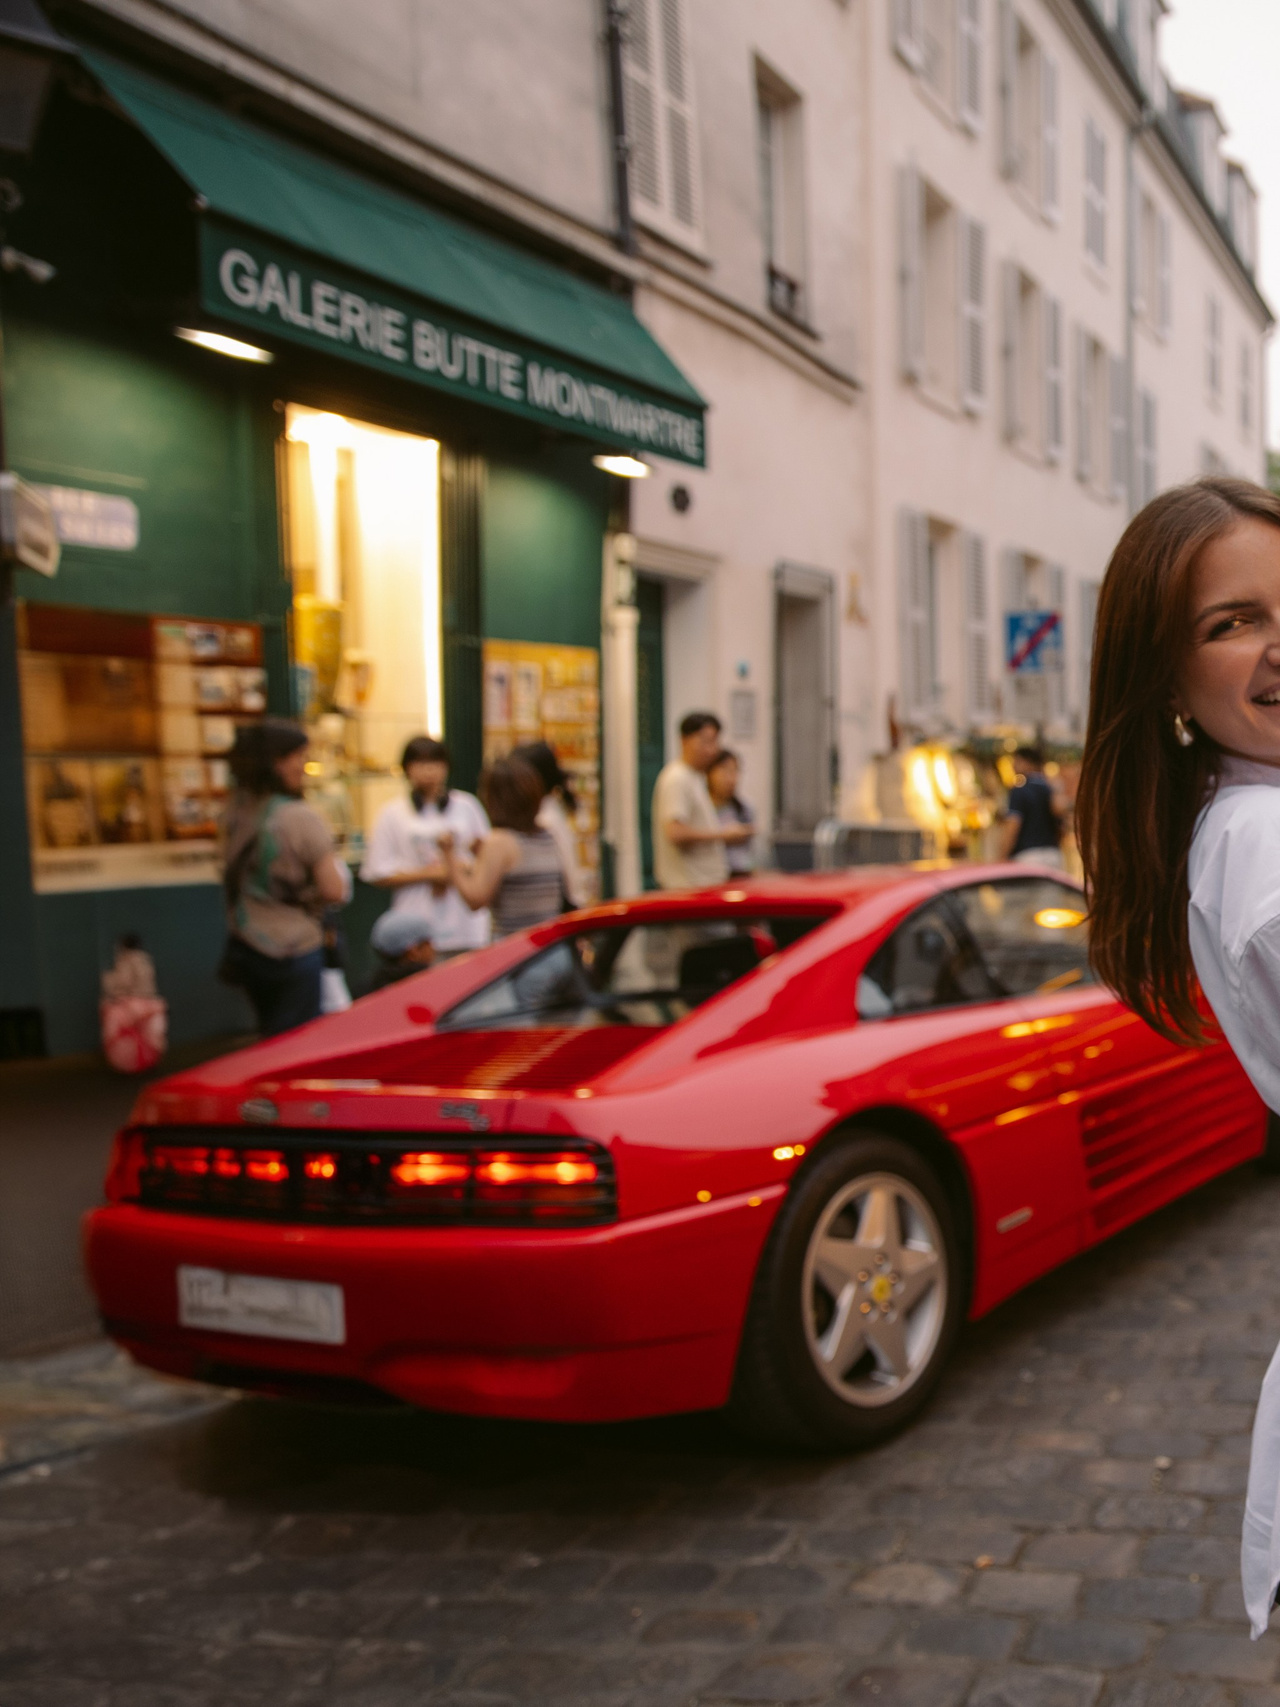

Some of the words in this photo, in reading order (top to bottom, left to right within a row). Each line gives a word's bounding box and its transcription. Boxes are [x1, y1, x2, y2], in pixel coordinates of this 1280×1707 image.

[218, 248, 408, 362] GALERIE
[412, 318, 525, 400] BUTTE
[526, 360, 703, 461] MONTMARTRE
